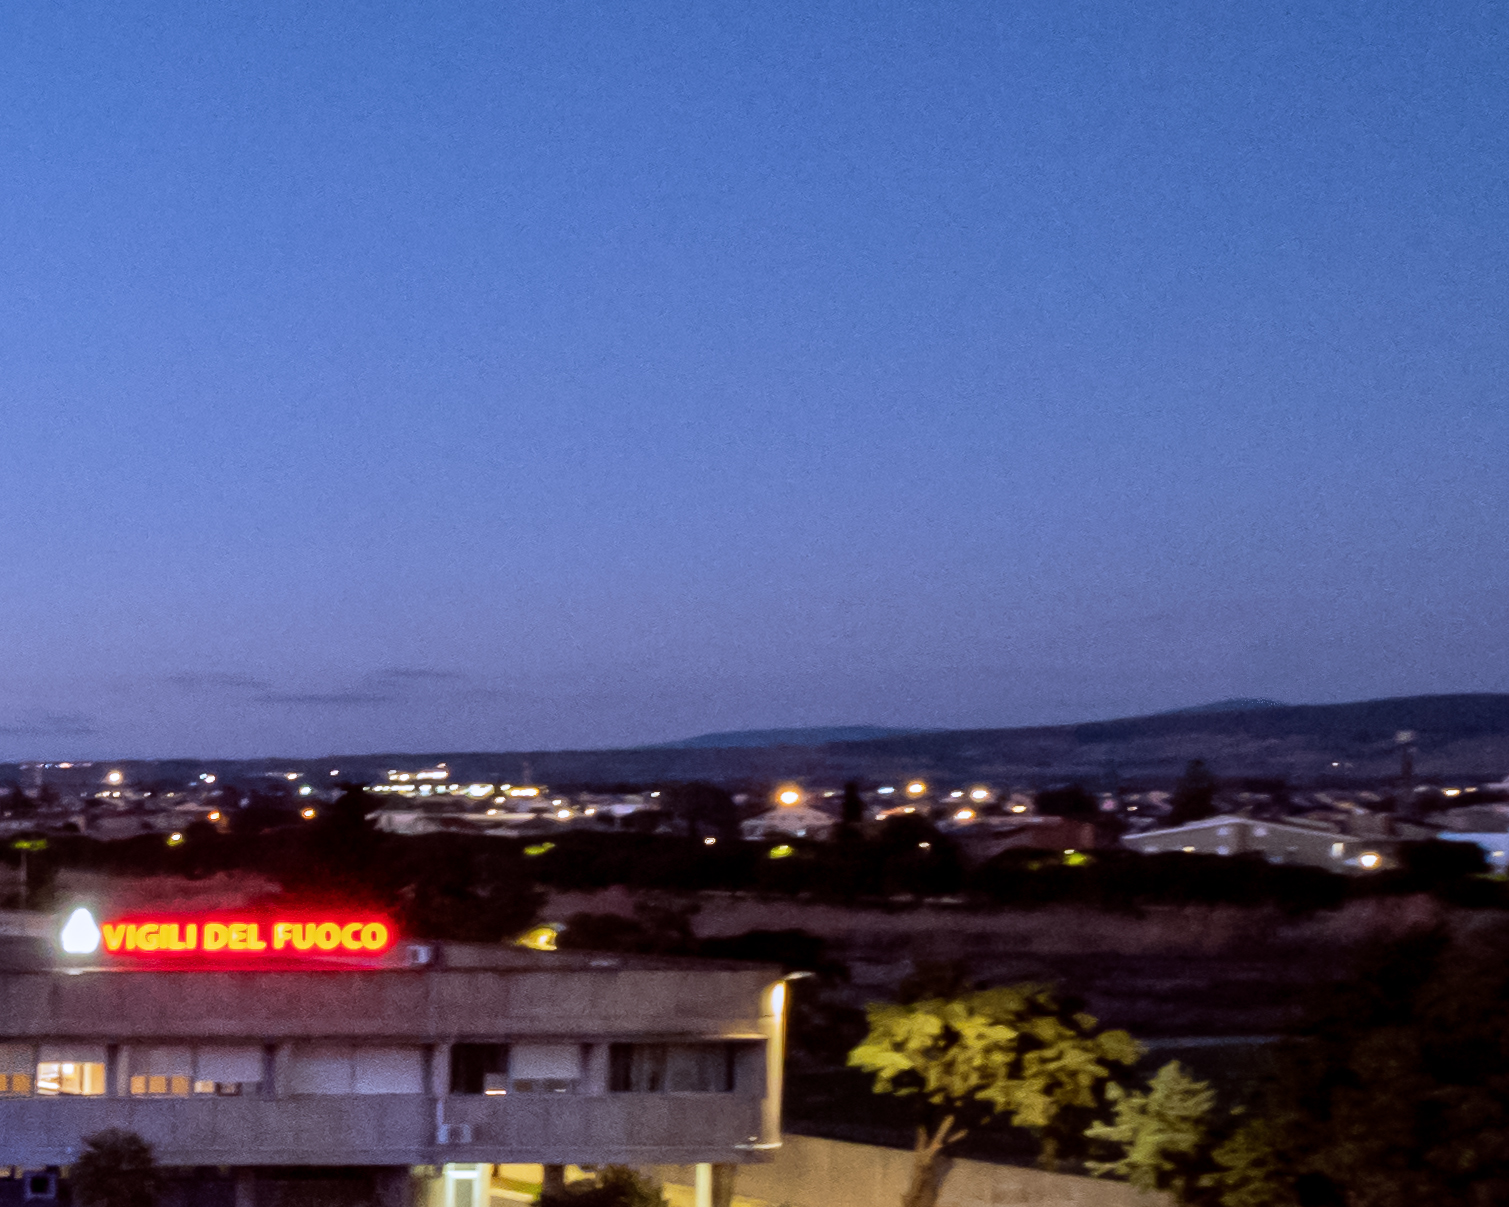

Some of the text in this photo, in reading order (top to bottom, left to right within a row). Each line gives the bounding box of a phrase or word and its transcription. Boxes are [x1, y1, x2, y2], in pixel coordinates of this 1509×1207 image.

[102, 922, 388, 951] VIGILI DEL FUOCO
